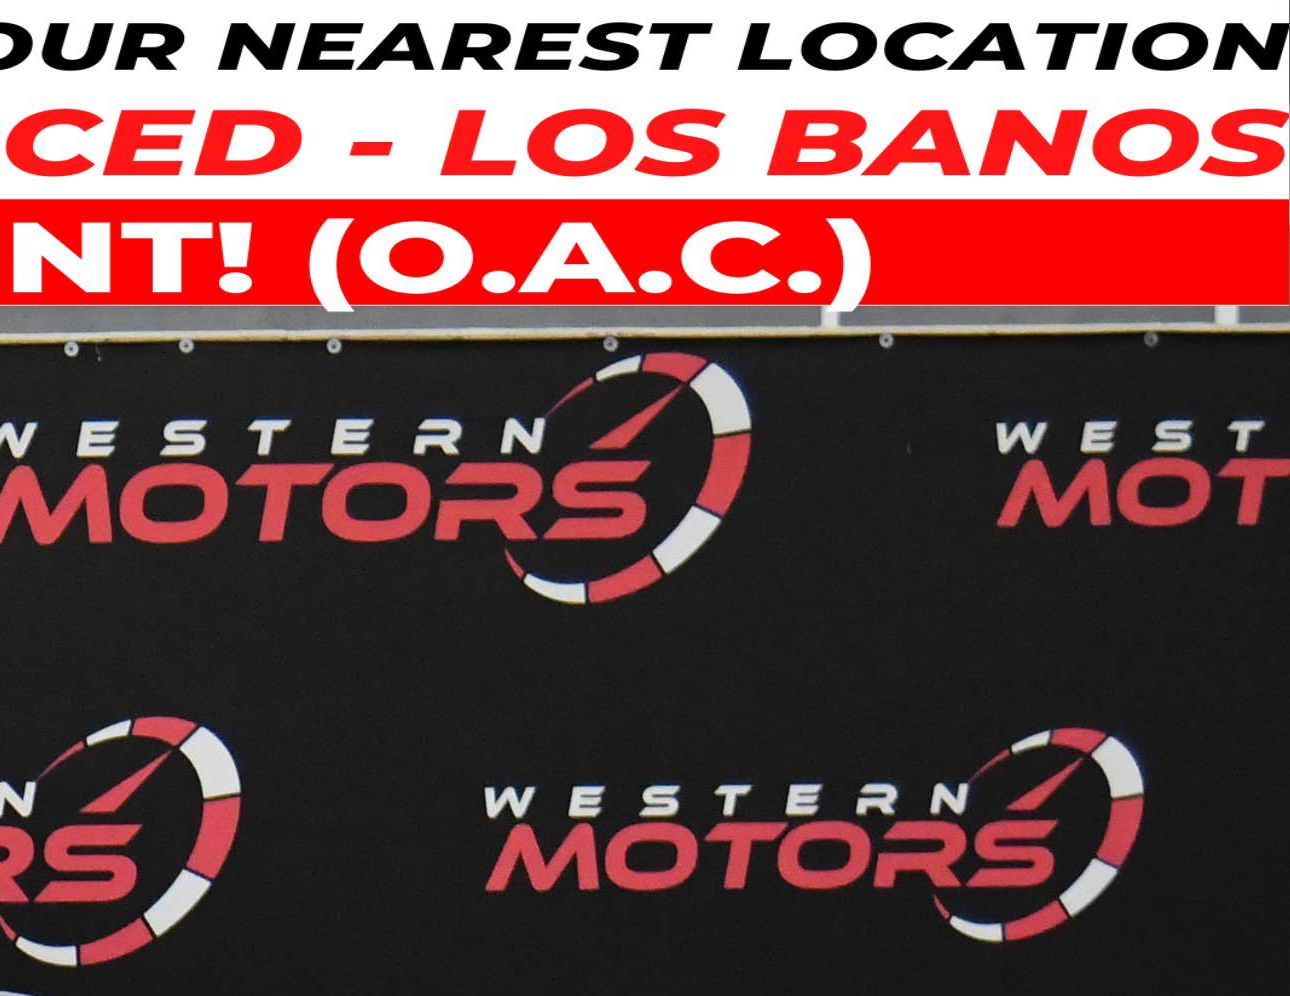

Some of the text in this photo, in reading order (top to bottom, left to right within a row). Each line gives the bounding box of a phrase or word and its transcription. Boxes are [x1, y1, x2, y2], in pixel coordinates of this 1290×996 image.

[995, 420, 1265, 455] WEST
[484, 783, 969, 819] WESTERN
[485, 820, 1058, 892] MOTORS
